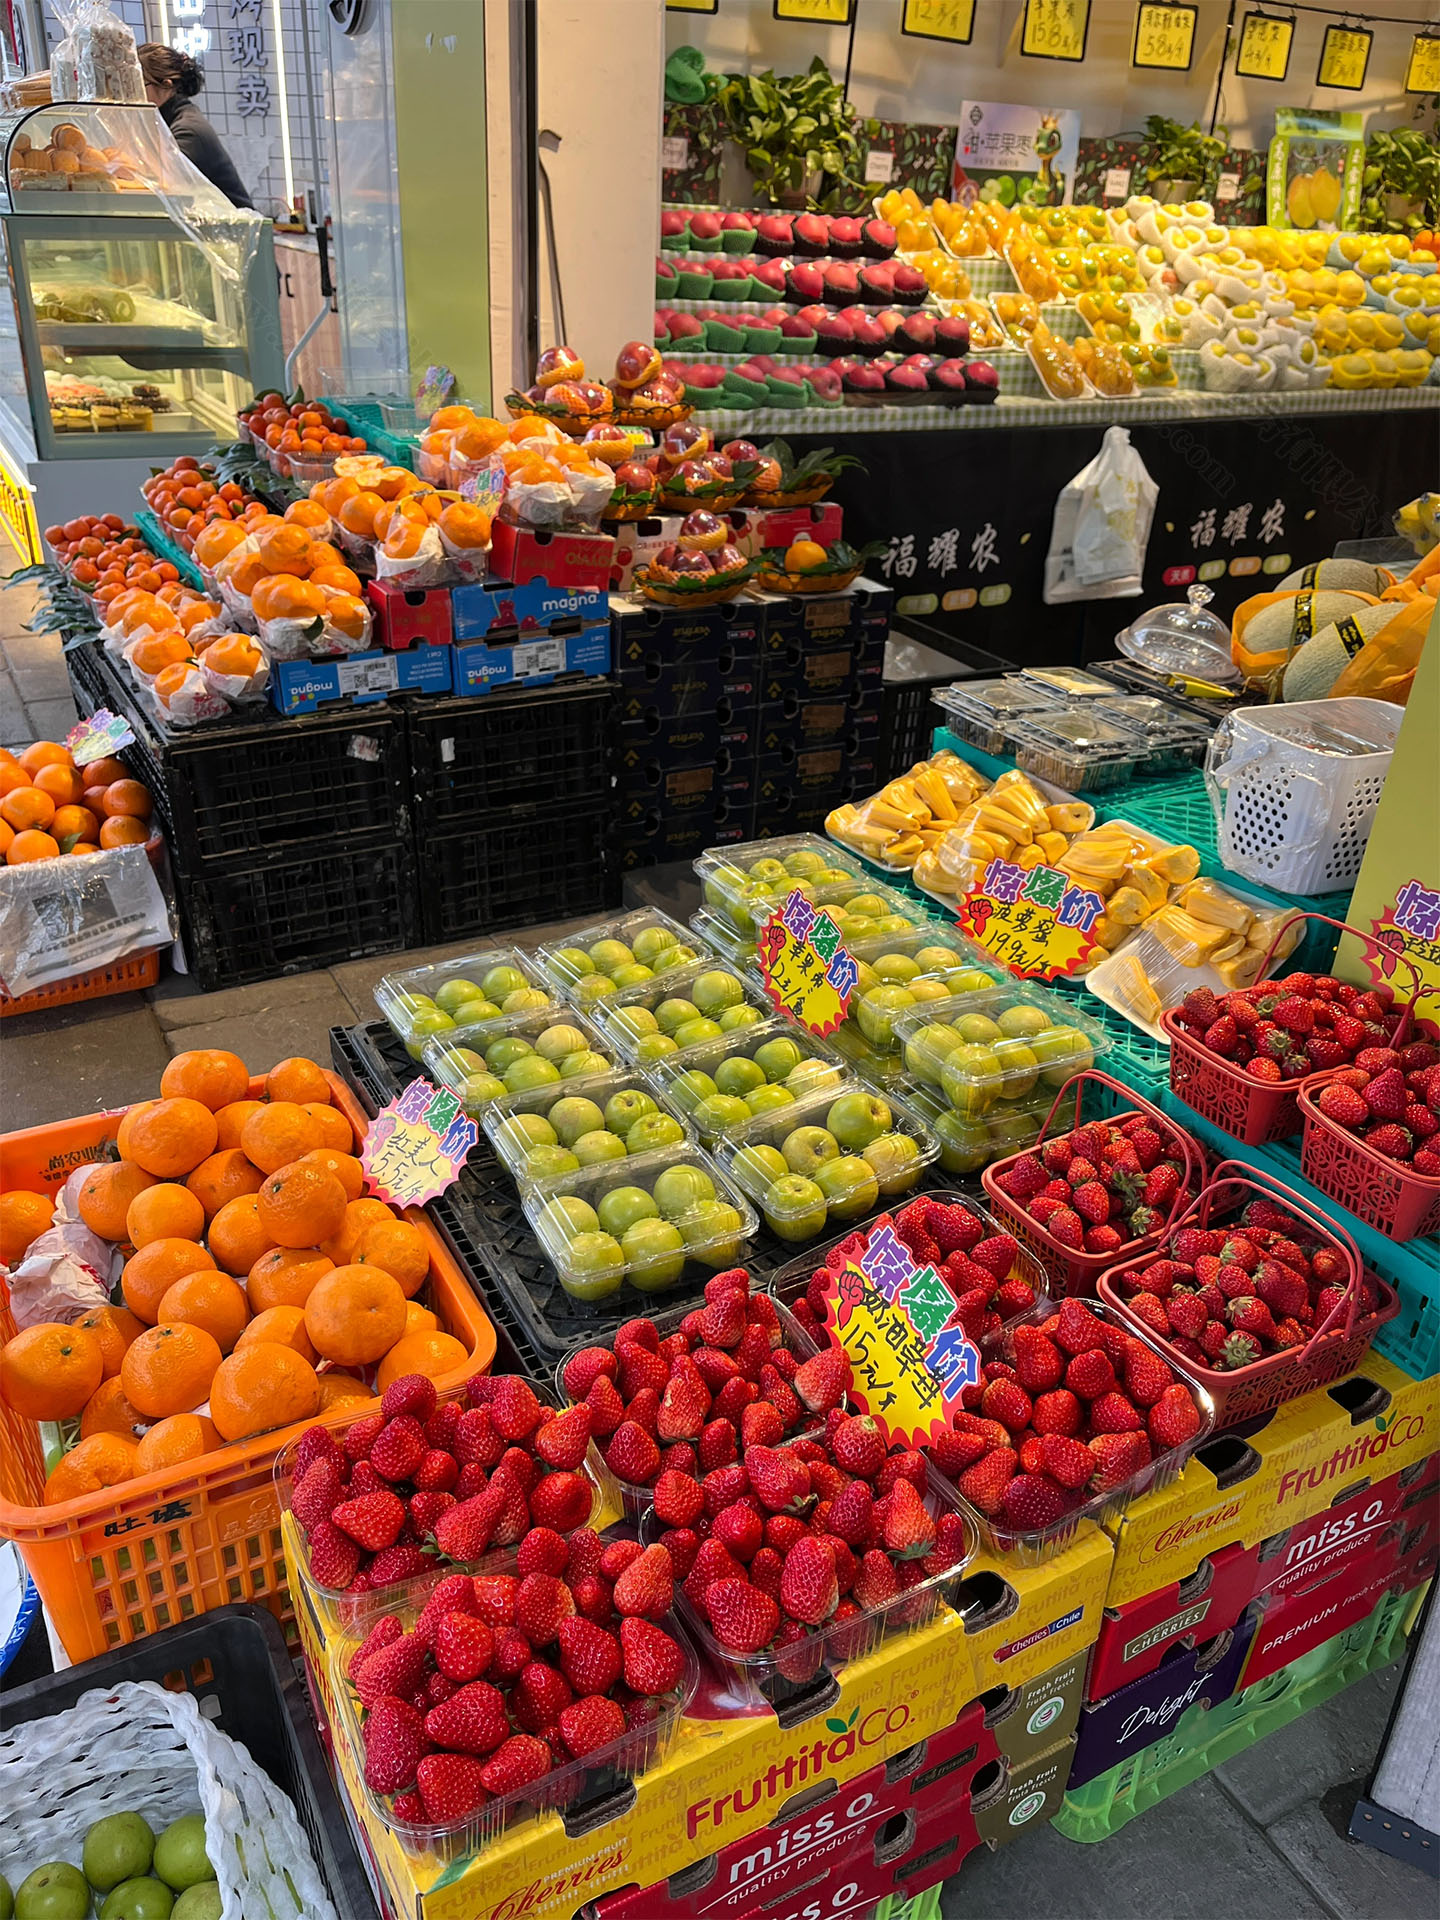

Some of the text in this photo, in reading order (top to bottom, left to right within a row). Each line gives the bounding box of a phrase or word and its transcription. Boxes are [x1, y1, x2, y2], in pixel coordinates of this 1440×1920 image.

[542, 594, 598, 612] magna
[291, 681, 333, 697] magna
[467, 665, 507, 679] magna
[983, 857, 1105, 932] 惊爆价
[782, 888, 859, 1000] 惊爆价
[395, 1077, 479, 1164] 惊爆价
[388, 1129, 441, 1177] 红美人
[861, 1225, 982, 1402] 惊爆价
[1146, 1501, 1245, 1561] Cherries
[1285, 1511, 1358, 1566] miss
[1278, 1533, 1371, 1589] quality produce
[1011, 1610, 1082, 1654] Cherries Chile
[1131, 1611, 1201, 1654] CHERRIES
[1262, 1603, 1338, 1655] PREMIUM
[1025, 1693, 1048, 1709] Fruta
[1027, 1667, 1076, 1700] Fresh Fruit
[1116, 1672, 1214, 1744] Delight
[1009, 1765, 1058, 1796] Fresh Fruit
[543, 1836, 630, 1883] PREMIUM FRUIT
[727, 1823, 867, 1906] quality produce
[729, 1811, 835, 1884] miss
[478, 1849, 632, 1919] Cherries
